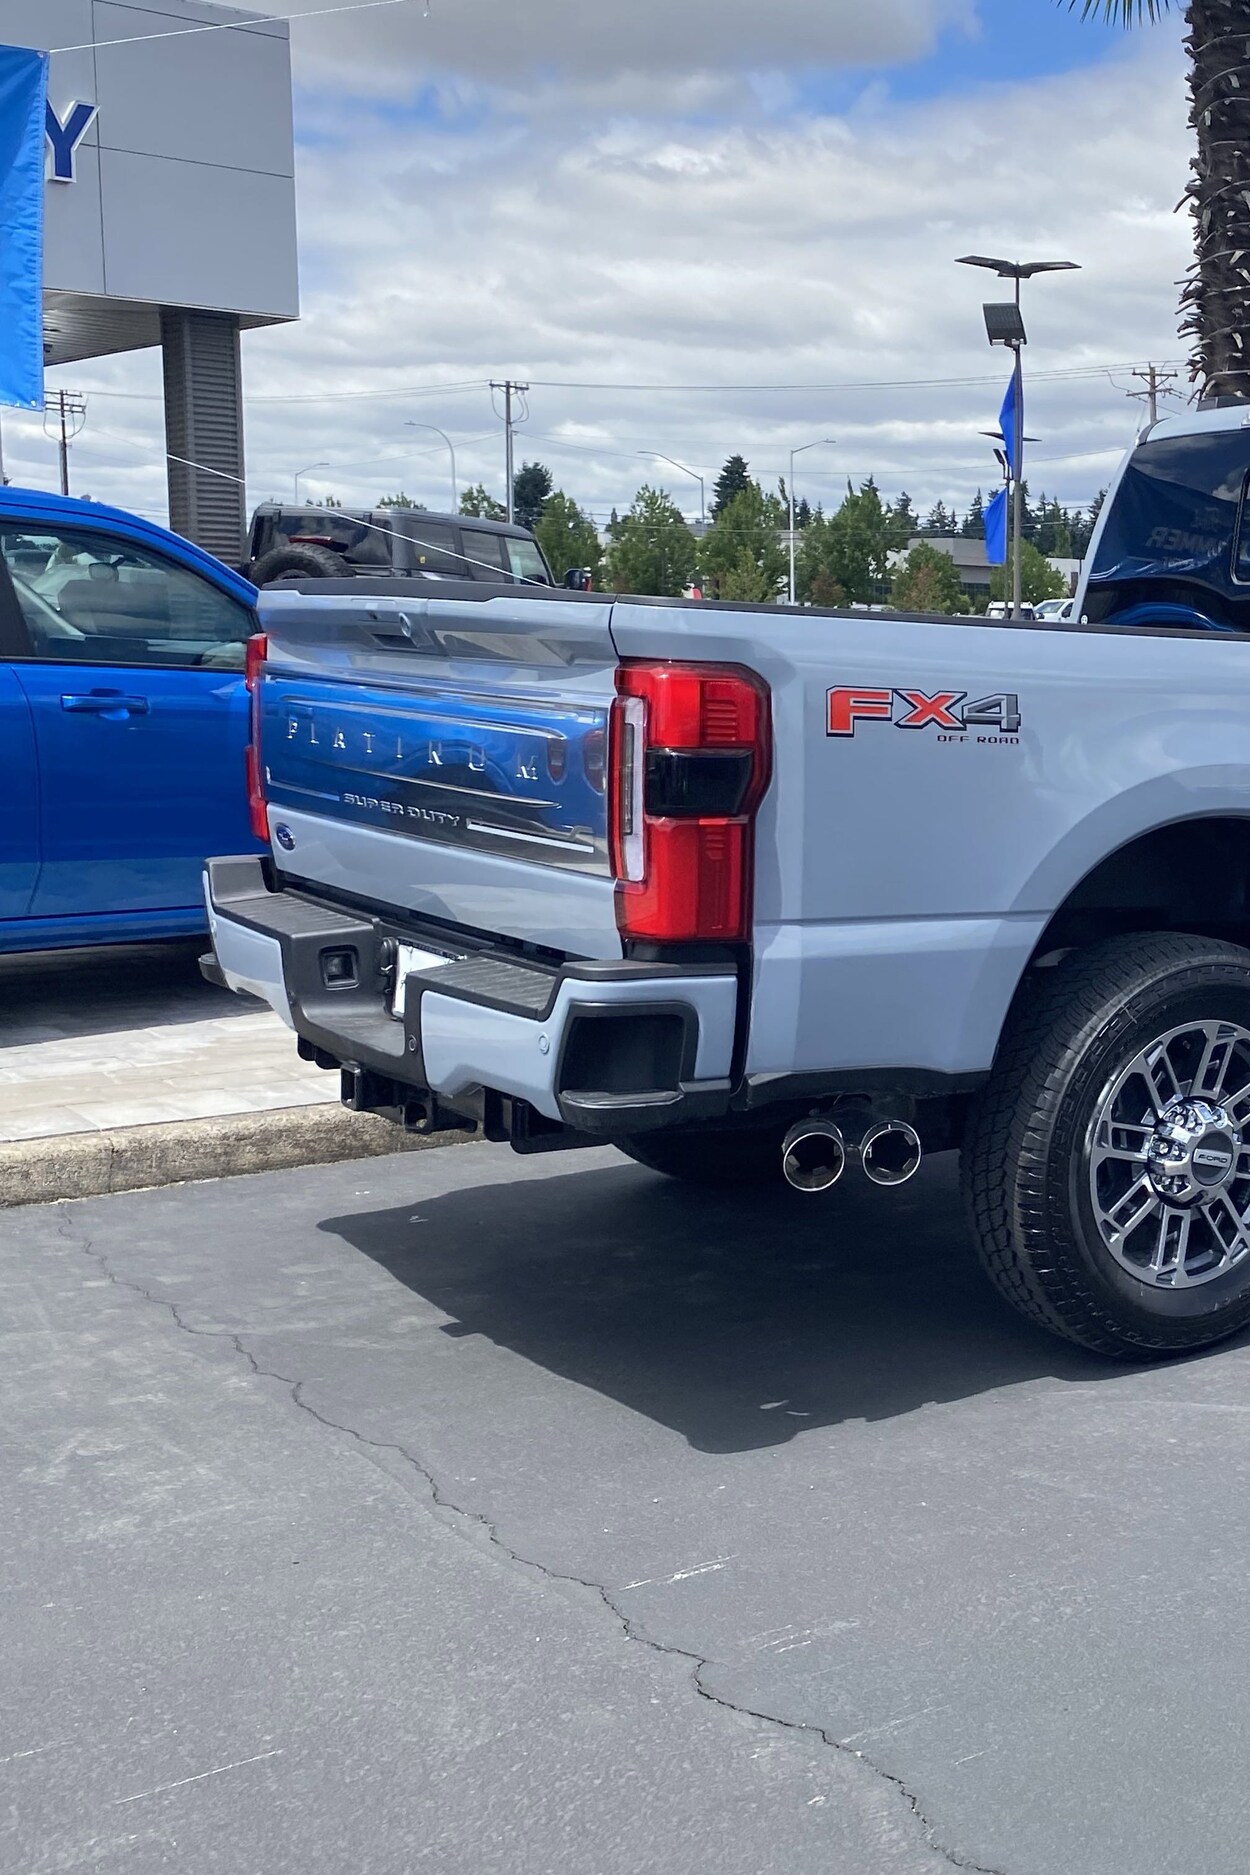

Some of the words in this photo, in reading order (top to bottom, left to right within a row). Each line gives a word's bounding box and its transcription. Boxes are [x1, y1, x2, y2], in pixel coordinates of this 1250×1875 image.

[826, 685, 1021, 737] FX4
[287, 716, 539, 780] PLATINUM
[937, 734, 970, 743] OFF
[977, 736, 1020, 745] ROAD
[343, 792, 404, 816] SUPER
[407, 805, 461, 827] DUTY
[1198, 1154, 1228, 1164] FORD
